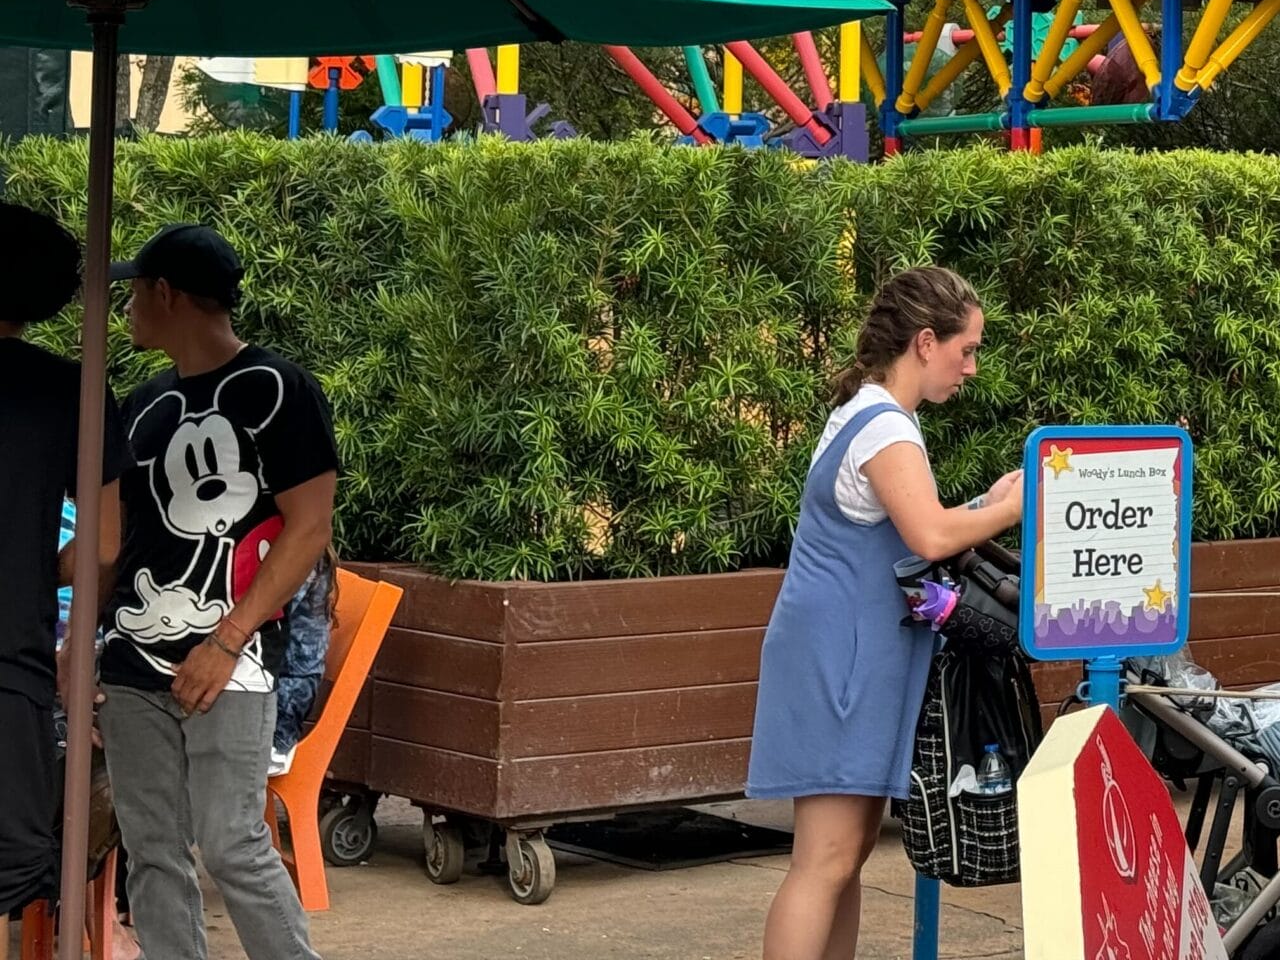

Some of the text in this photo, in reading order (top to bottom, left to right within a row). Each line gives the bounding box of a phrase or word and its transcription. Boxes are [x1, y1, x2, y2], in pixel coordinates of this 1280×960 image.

[1078, 466, 1167, 481] Woody's Lunch Box
[1065, 498, 1153, 531] Order
[1072, 548, 1143, 577] Here
